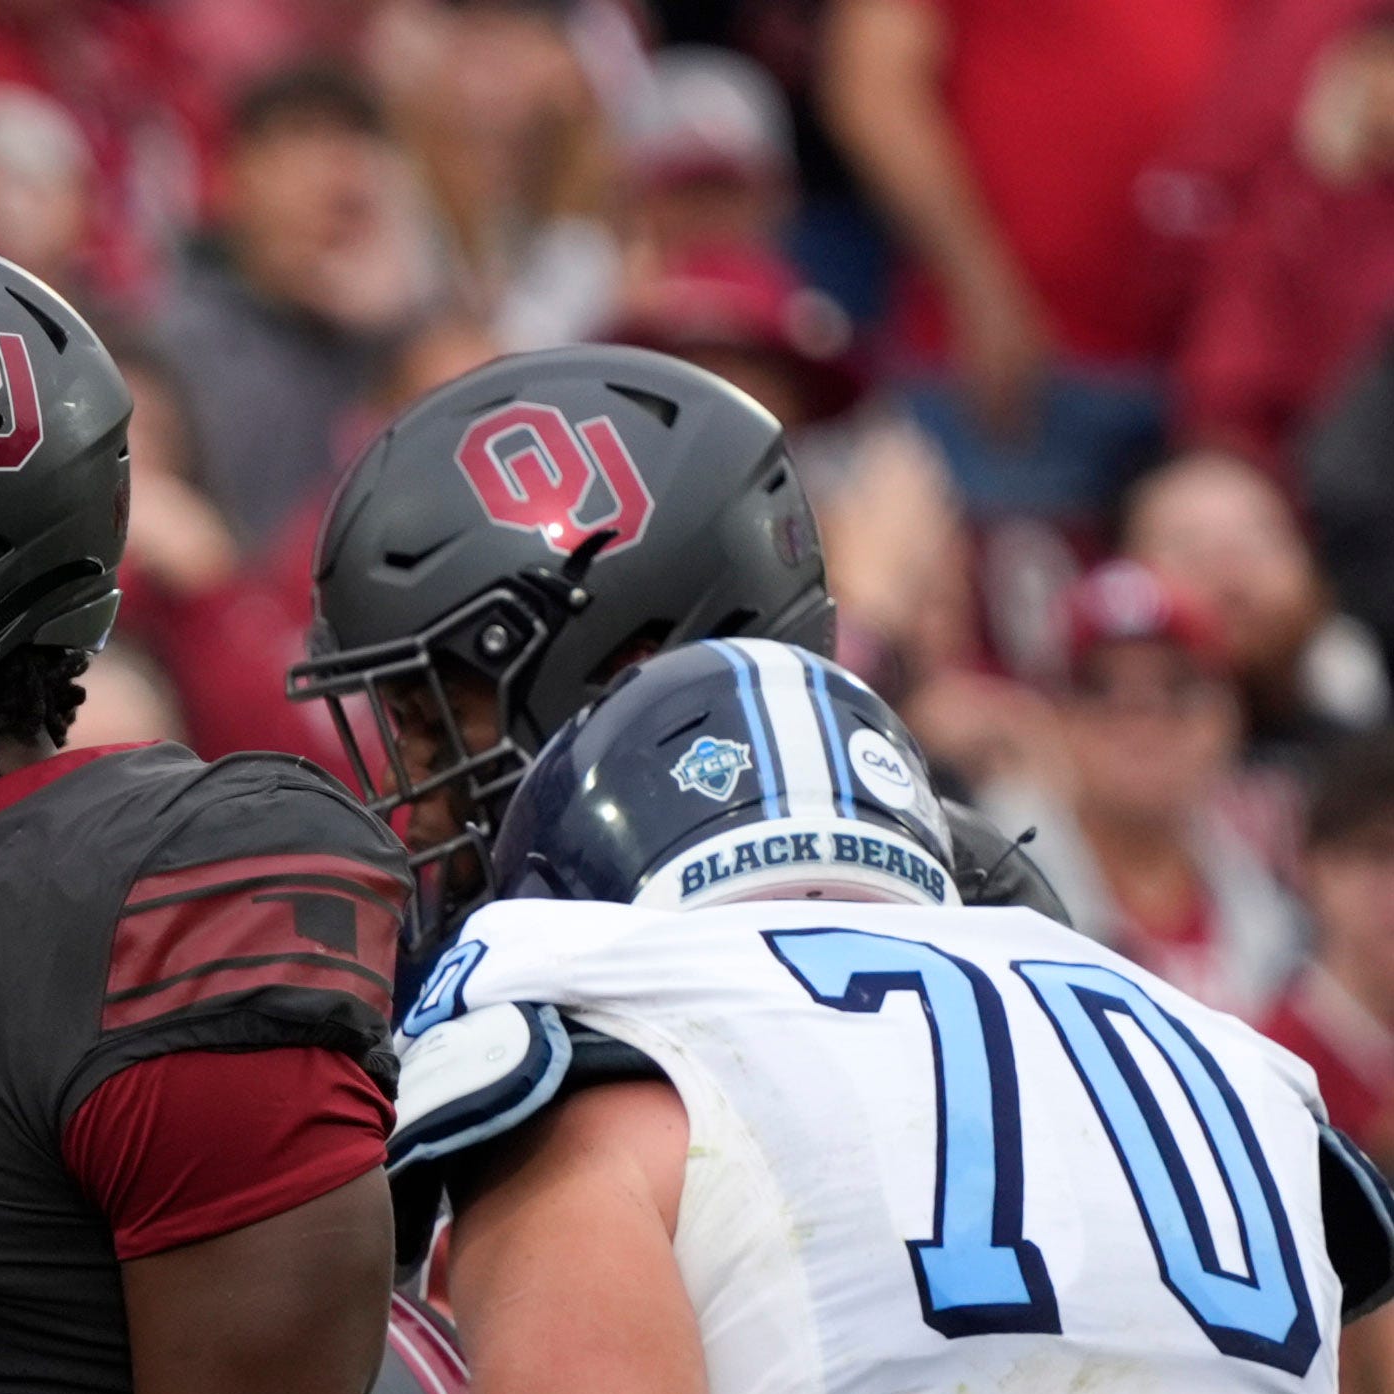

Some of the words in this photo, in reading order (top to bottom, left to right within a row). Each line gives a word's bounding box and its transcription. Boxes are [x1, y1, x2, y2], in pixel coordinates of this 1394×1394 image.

[453, 401, 655, 560] OU
[862, 749, 903, 780] CAA
[680, 833, 820, 898] BLACK
[831, 833, 946, 905] BEARS
[761, 926, 1321, 1378] 70
